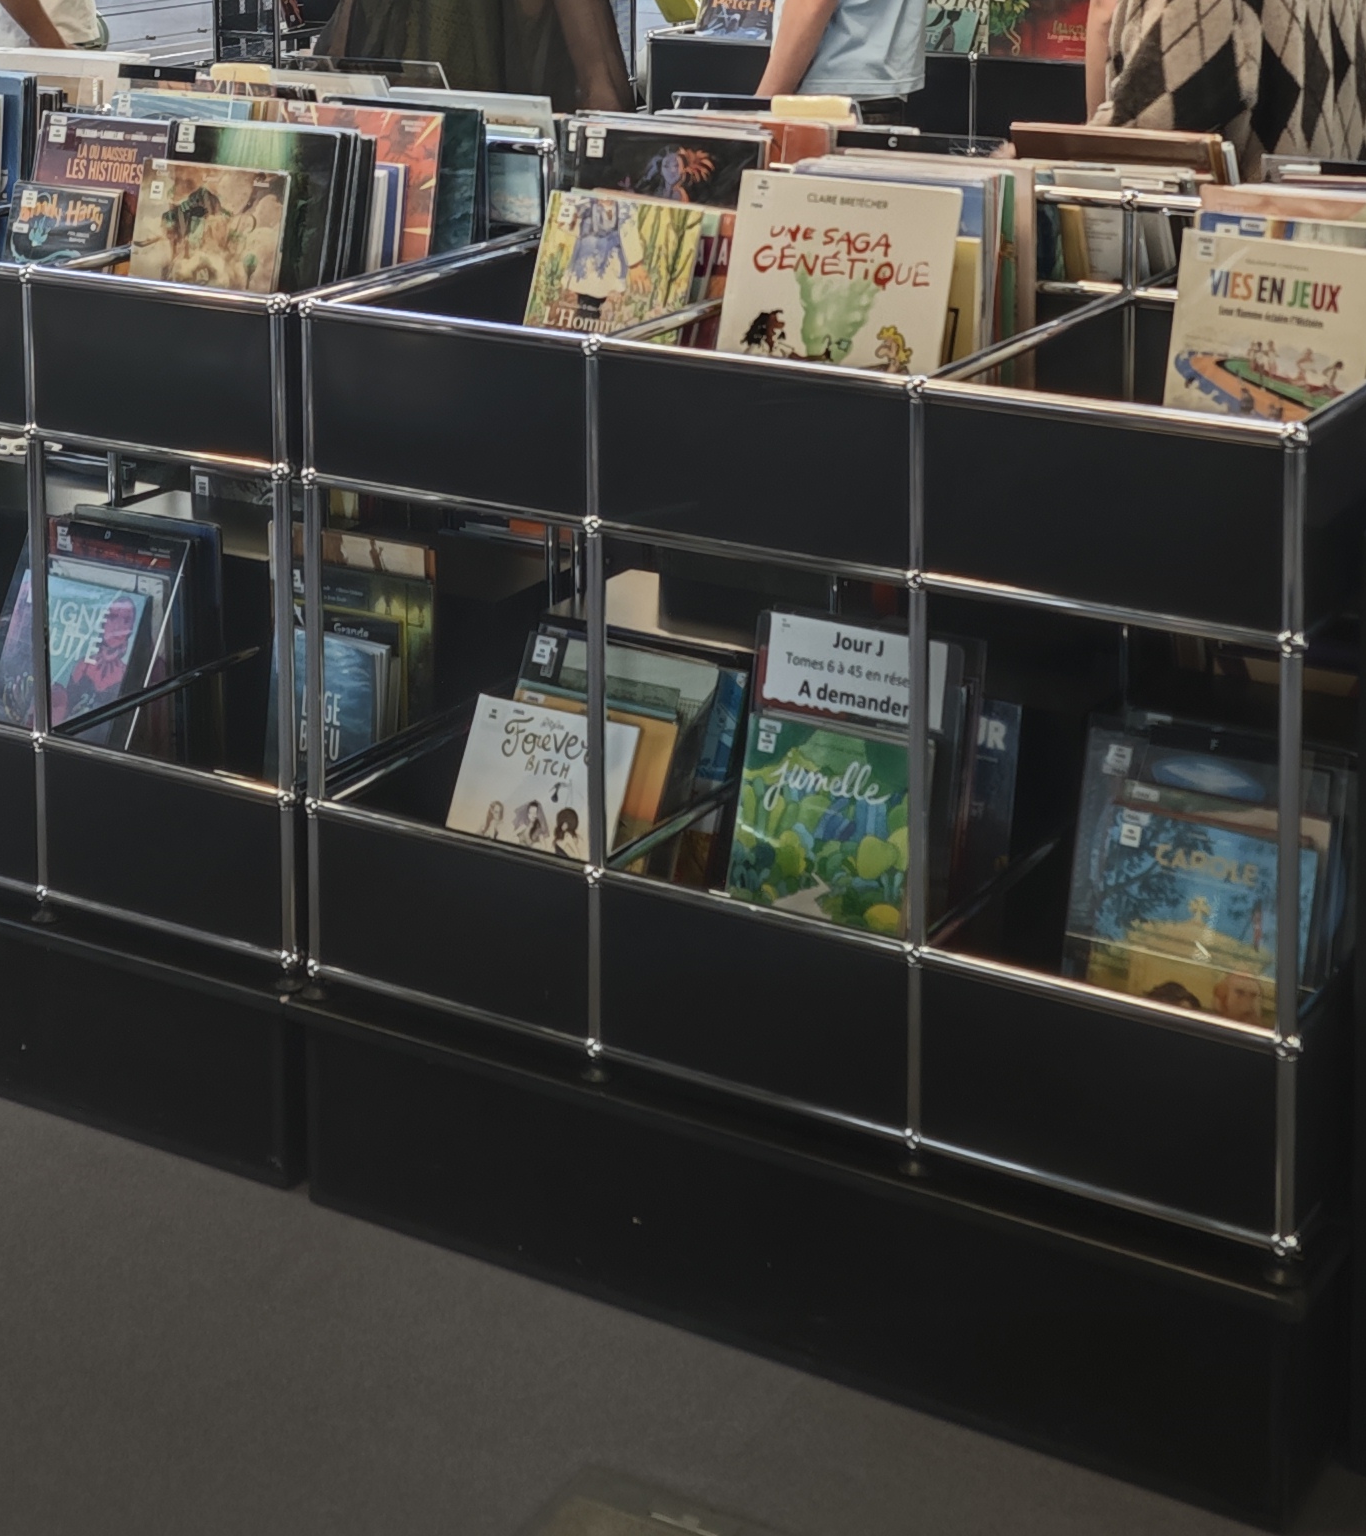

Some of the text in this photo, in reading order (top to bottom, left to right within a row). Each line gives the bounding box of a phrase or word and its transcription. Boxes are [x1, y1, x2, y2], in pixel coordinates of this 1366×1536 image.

[101, 146, 139, 163] NAISSENT
[888, 136, 898, 148] C
[65, 158, 144, 185] LES HISTOIRES
[807, 191, 840, 207] CLAIRE
[66, 200, 104, 234] Harry
[770, 223, 892, 258] UNE SAGA
[1210, 268, 1343, 313] VIES EN JEUX
[832, 630, 885, 659] Jour J
[785, 651, 881, 681] Tomes 6 à 45 en
[798, 679, 910, 718] A demander
[524, 758, 572, 781] BITCH
[762, 757, 889, 813] jumelle
[1154, 842, 1260, 889] CAROLE
